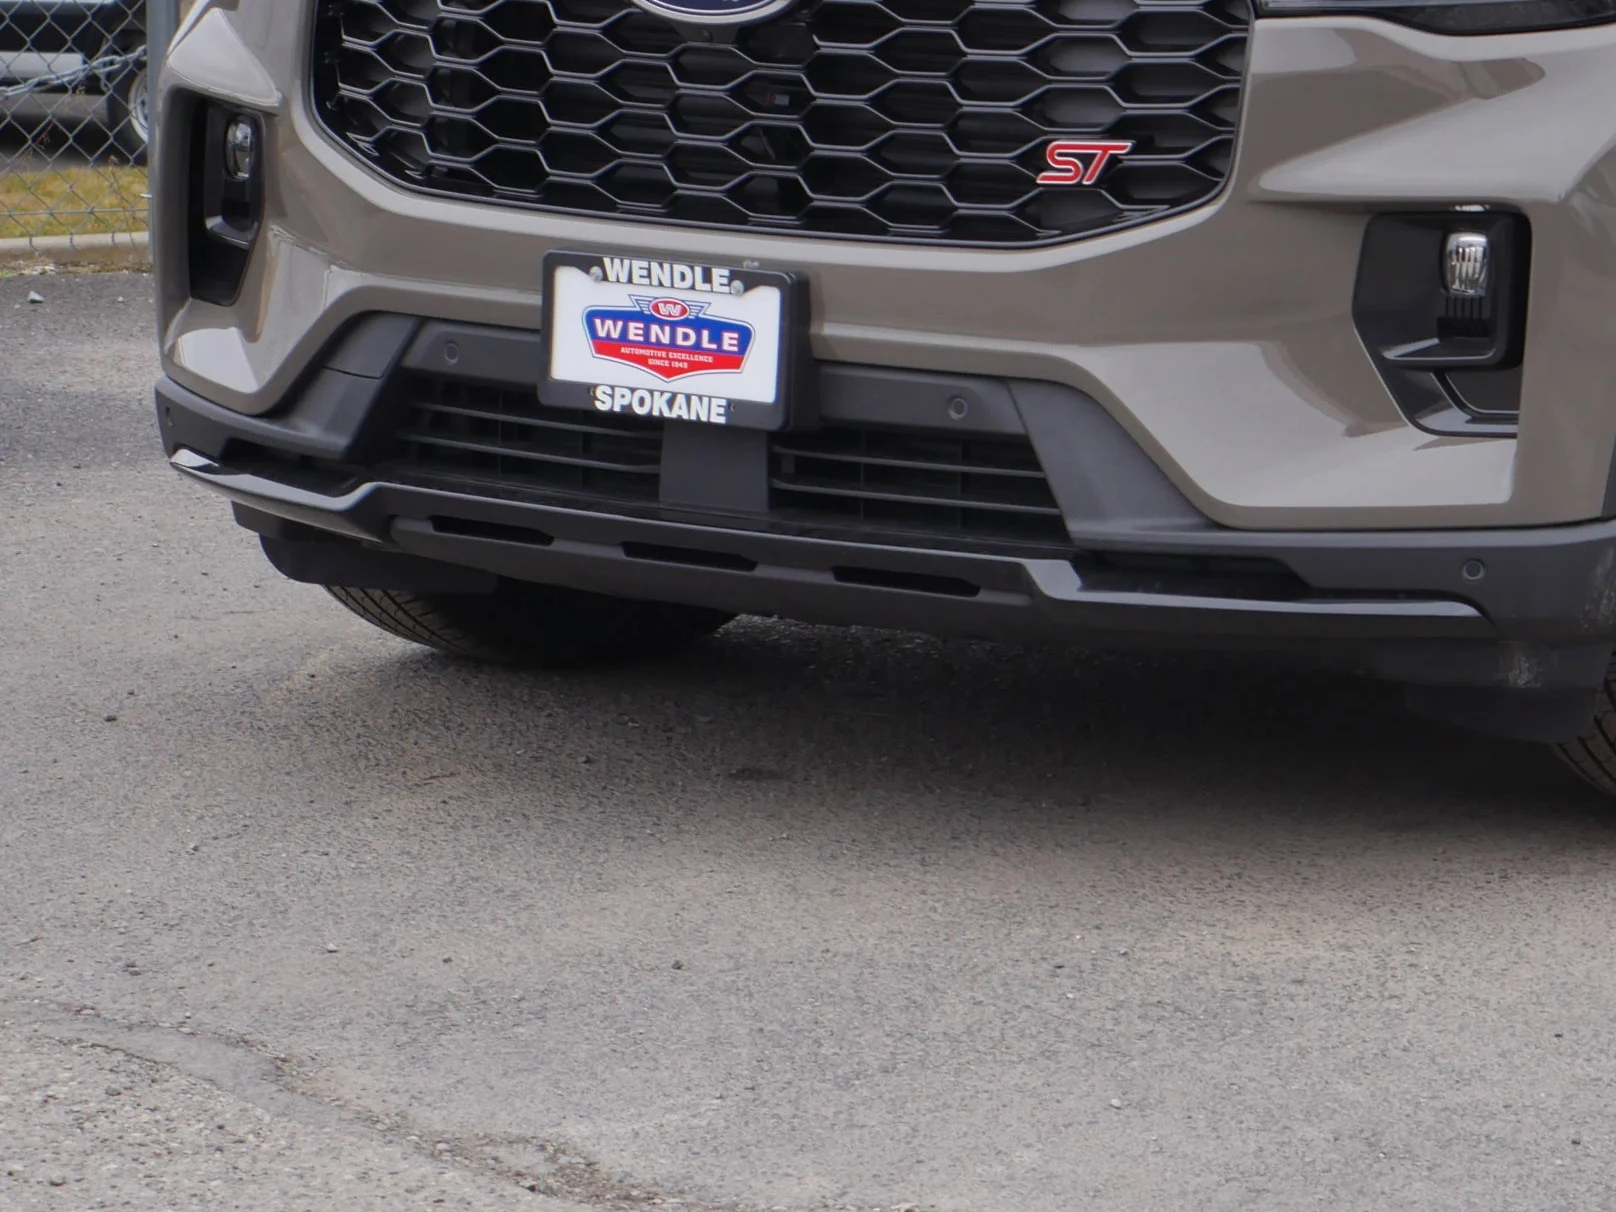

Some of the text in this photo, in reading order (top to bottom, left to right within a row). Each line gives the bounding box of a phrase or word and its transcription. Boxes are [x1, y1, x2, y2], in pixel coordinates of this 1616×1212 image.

[1036, 140, 1134, 185] ST
[603, 257, 730, 294] WENDLE
[593, 319, 739, 352] WENDLE
[620, 346, 713, 363] AUTOMOTIVE EXCELLENCE
[647, 358, 688, 369] SINCE 1943
[594, 385, 727, 424] SPOKANE
